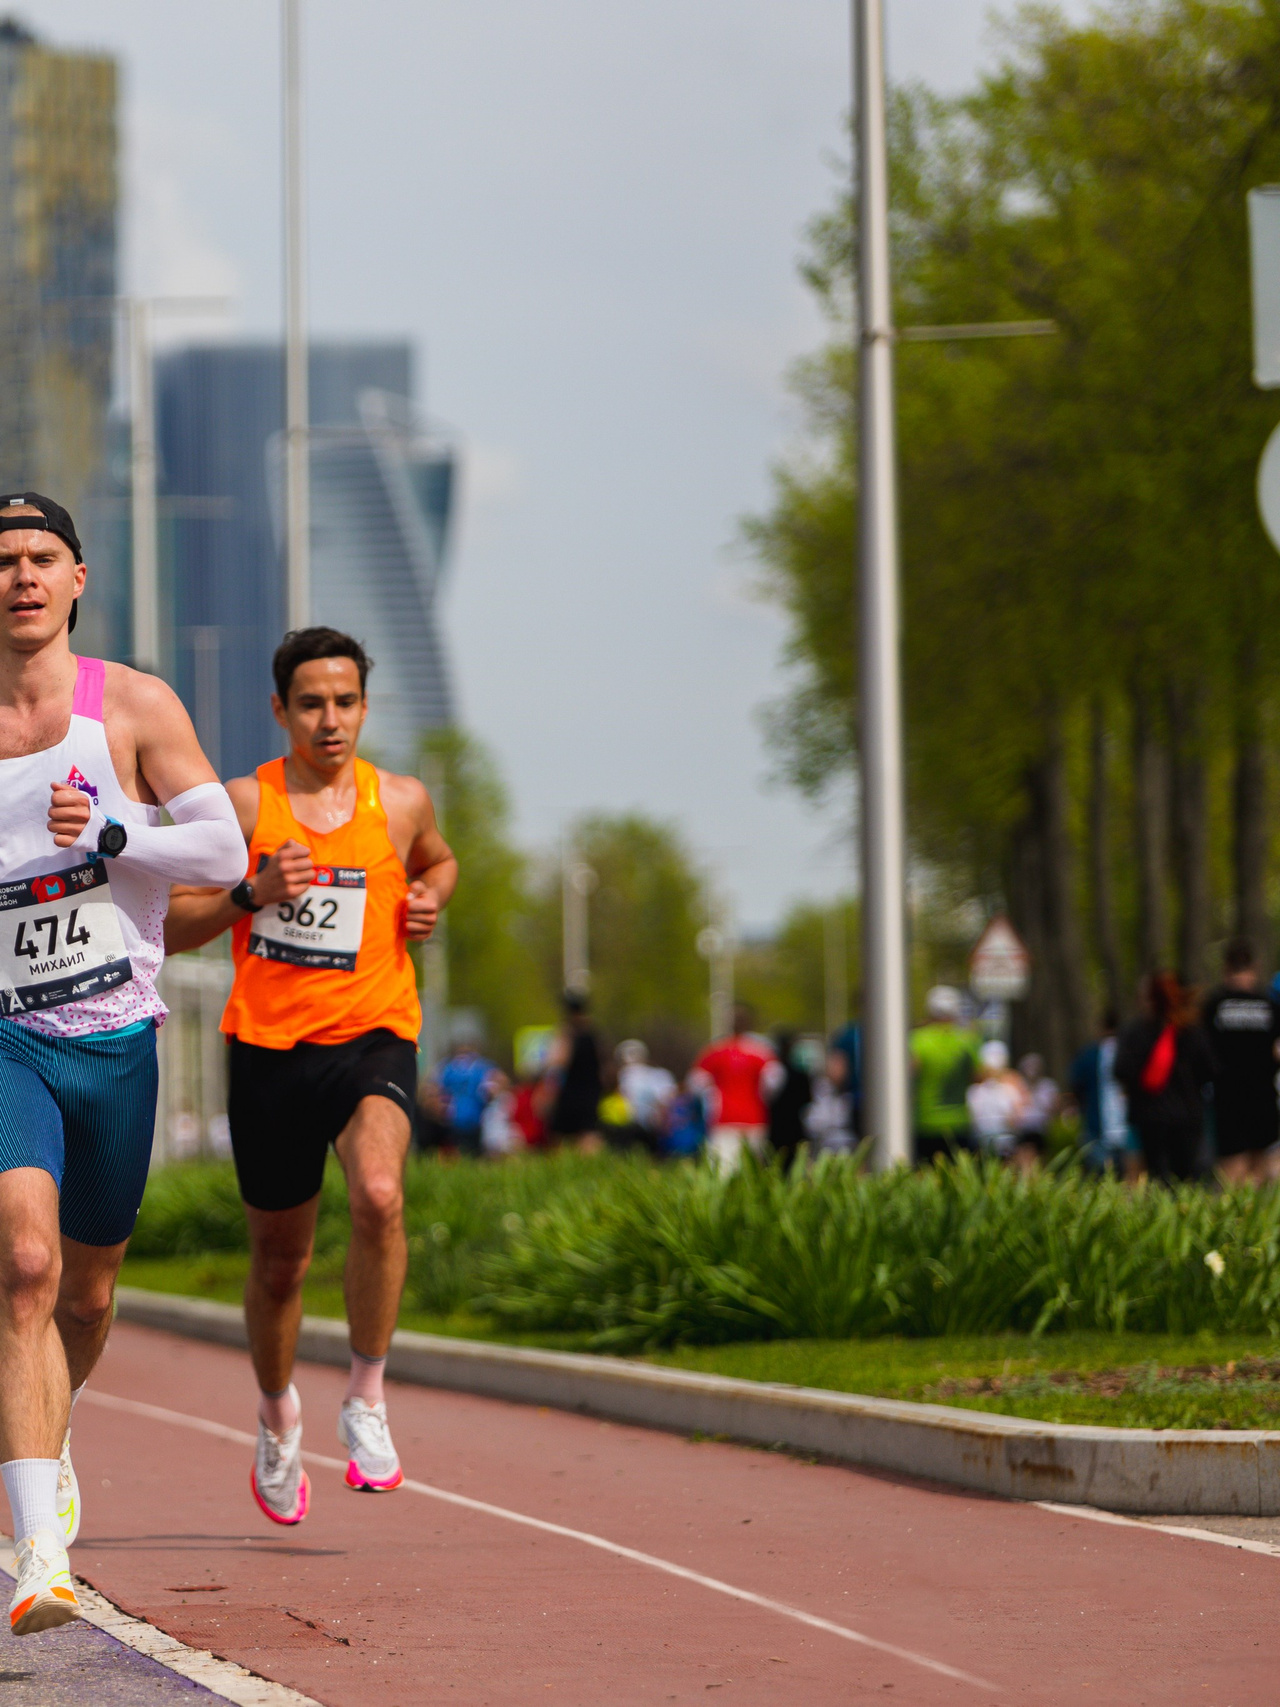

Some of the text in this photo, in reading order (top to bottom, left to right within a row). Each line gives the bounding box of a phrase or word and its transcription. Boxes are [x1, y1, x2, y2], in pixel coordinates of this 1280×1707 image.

[277, 897, 338, 929] 562
[14, 908, 91, 960] 474
[283, 926, 324, 940] SERGEY
[29, 952, 85, 976] МИХАИЛ
